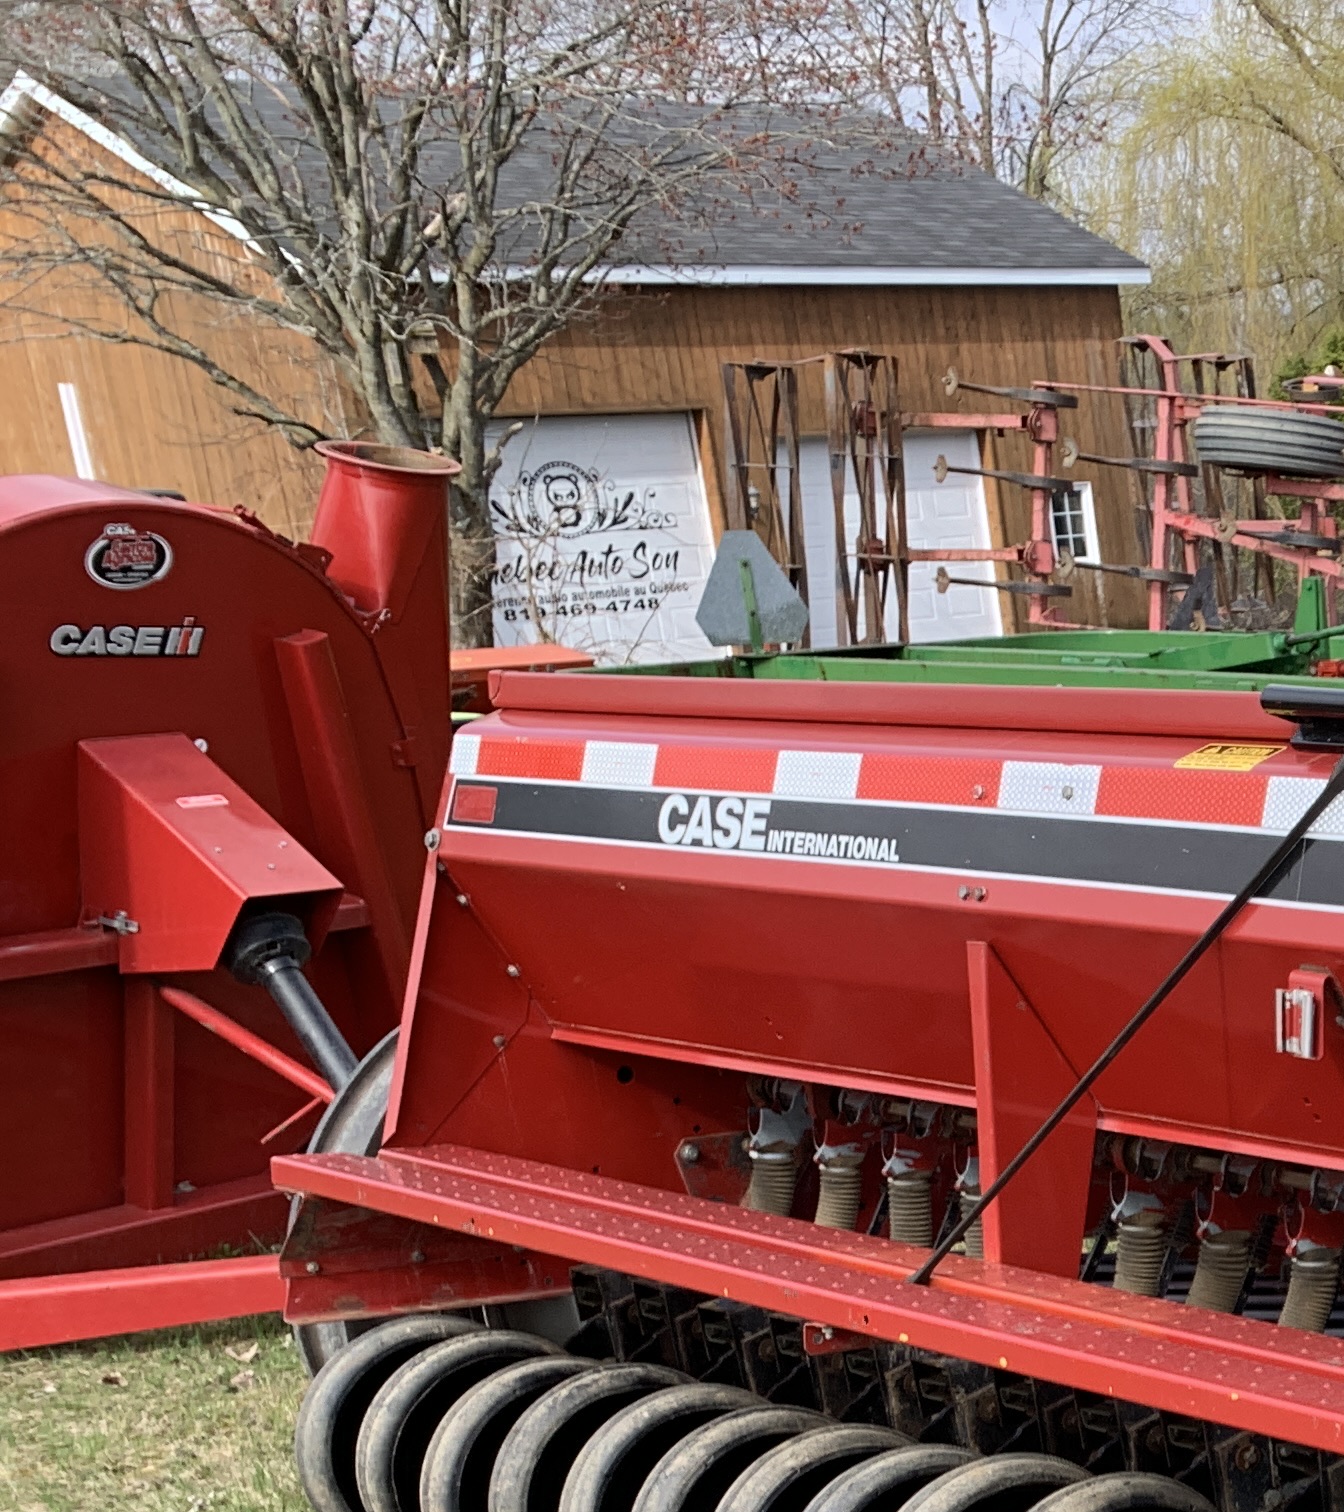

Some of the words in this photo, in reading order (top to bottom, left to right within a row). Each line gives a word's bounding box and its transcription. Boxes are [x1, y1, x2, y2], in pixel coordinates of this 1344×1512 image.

[630, 540, 680, 579] Son
[50, 624, 165, 656] CASE
[657, 793, 772, 851] CASE
[767, 829, 900, 862] INTERNATIONAL
